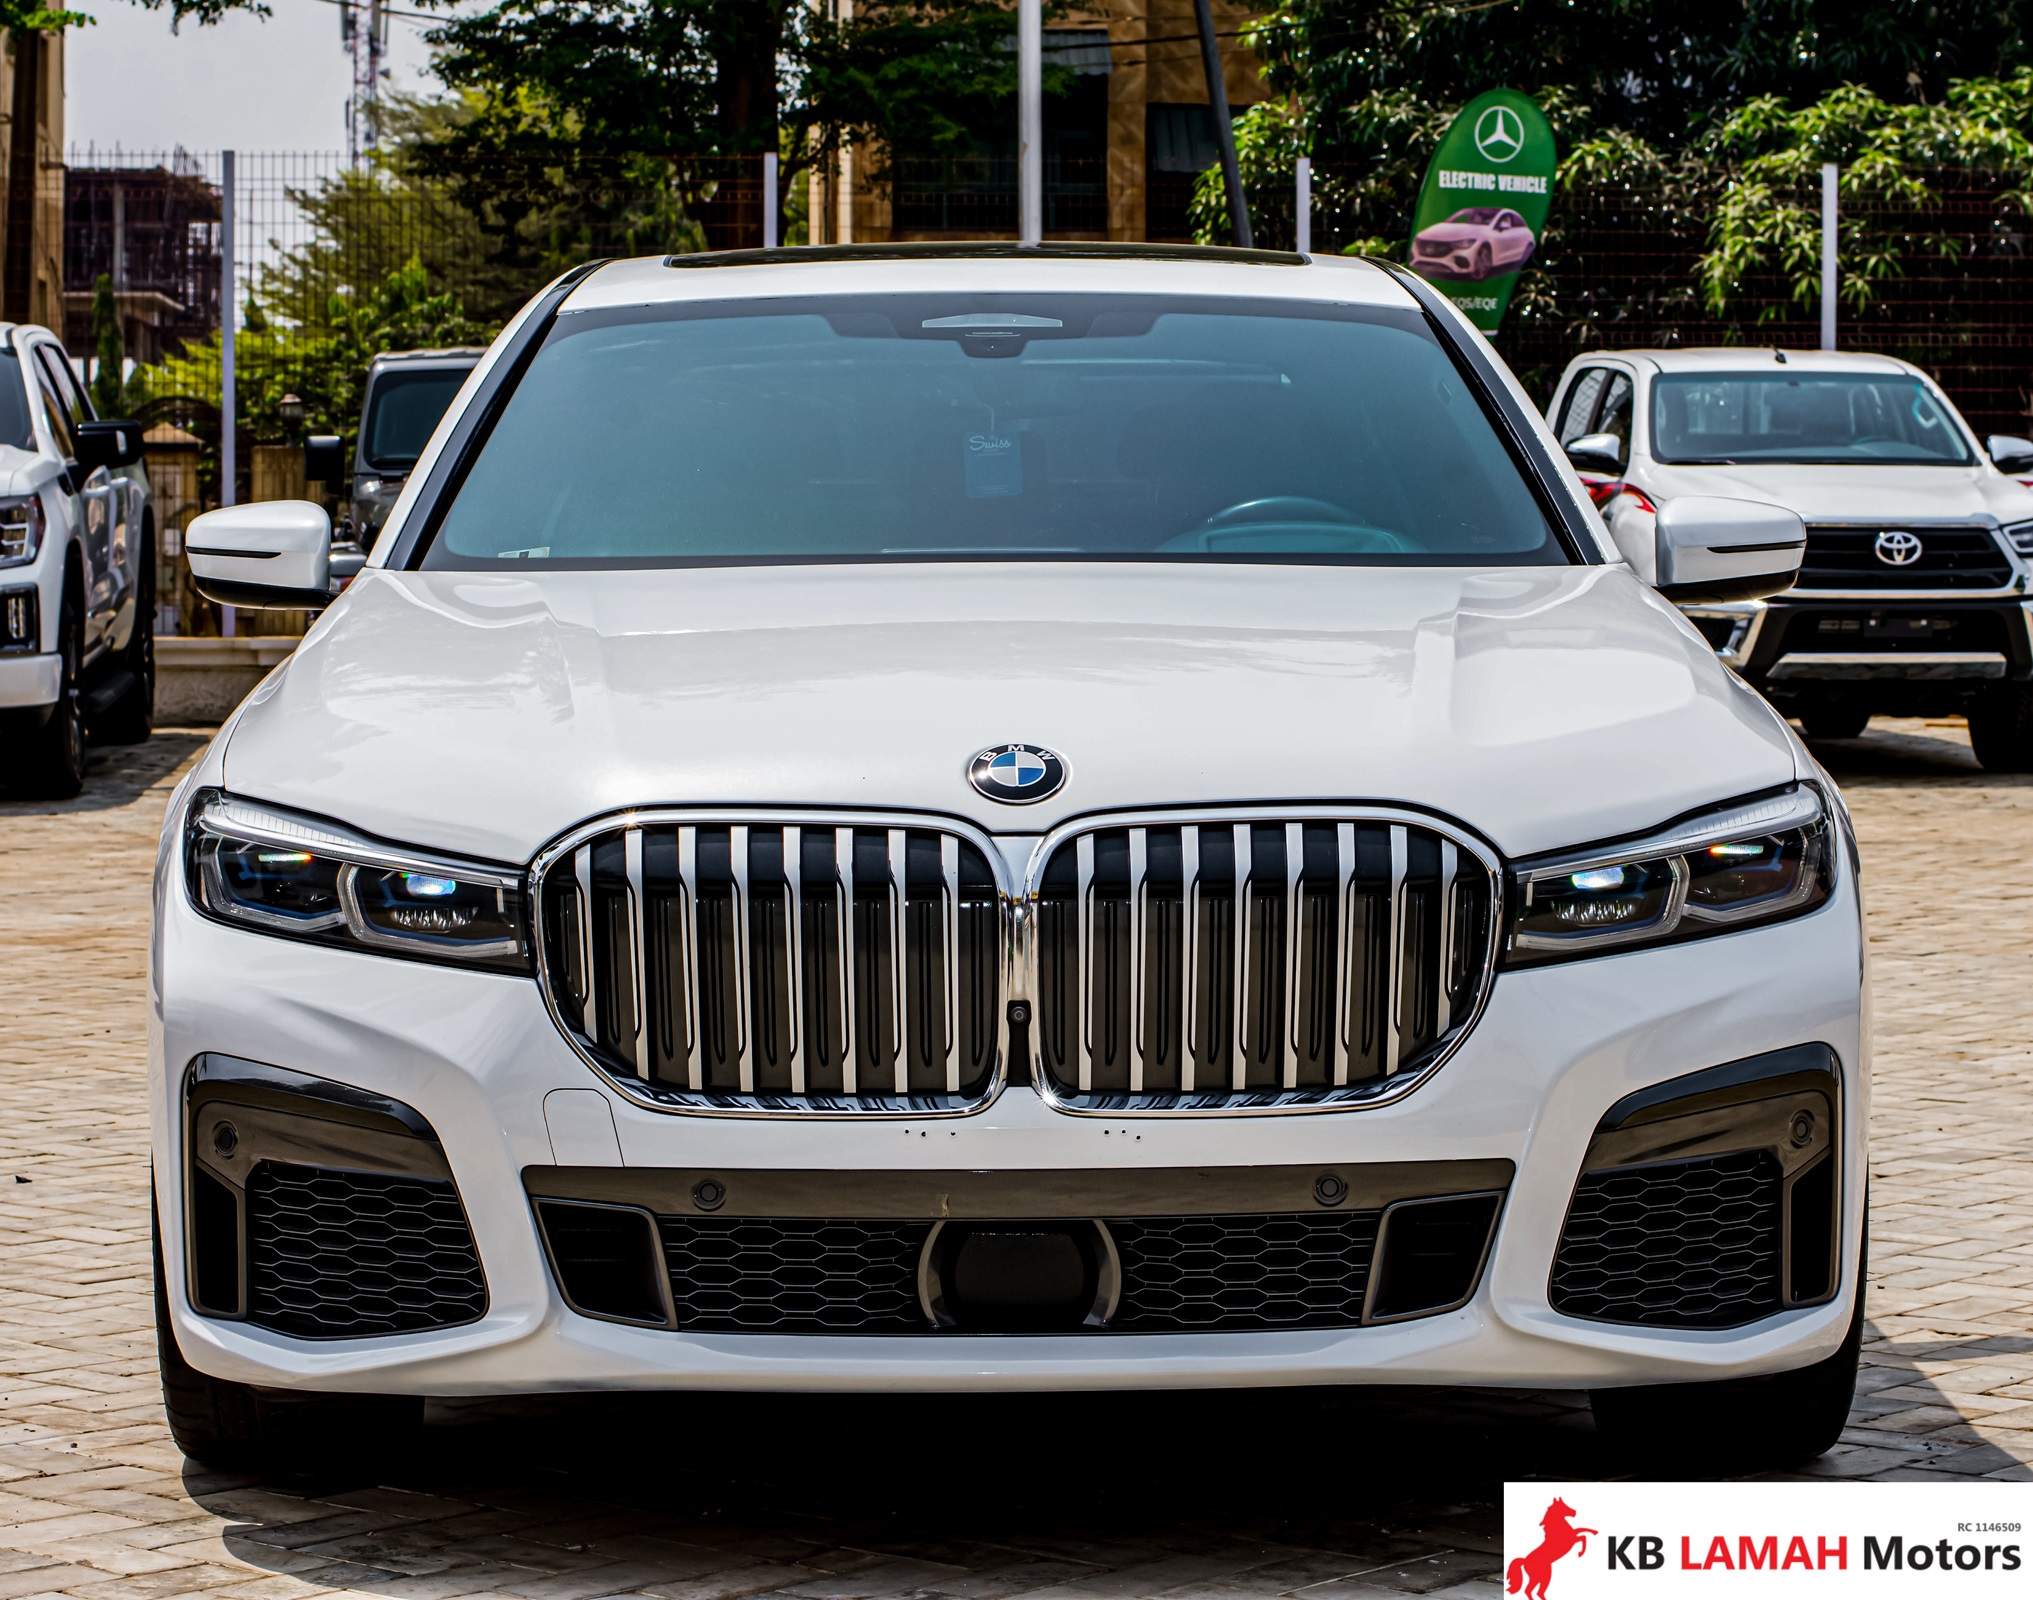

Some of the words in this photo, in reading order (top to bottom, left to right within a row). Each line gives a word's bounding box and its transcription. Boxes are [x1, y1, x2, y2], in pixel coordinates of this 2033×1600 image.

[1439, 170, 1496, 191] ELECTRIC
[1498, 174, 1547, 194] VEHICLE
[969, 435, 1012, 451] Swiss
[979, 744, 1055, 761] BMW
